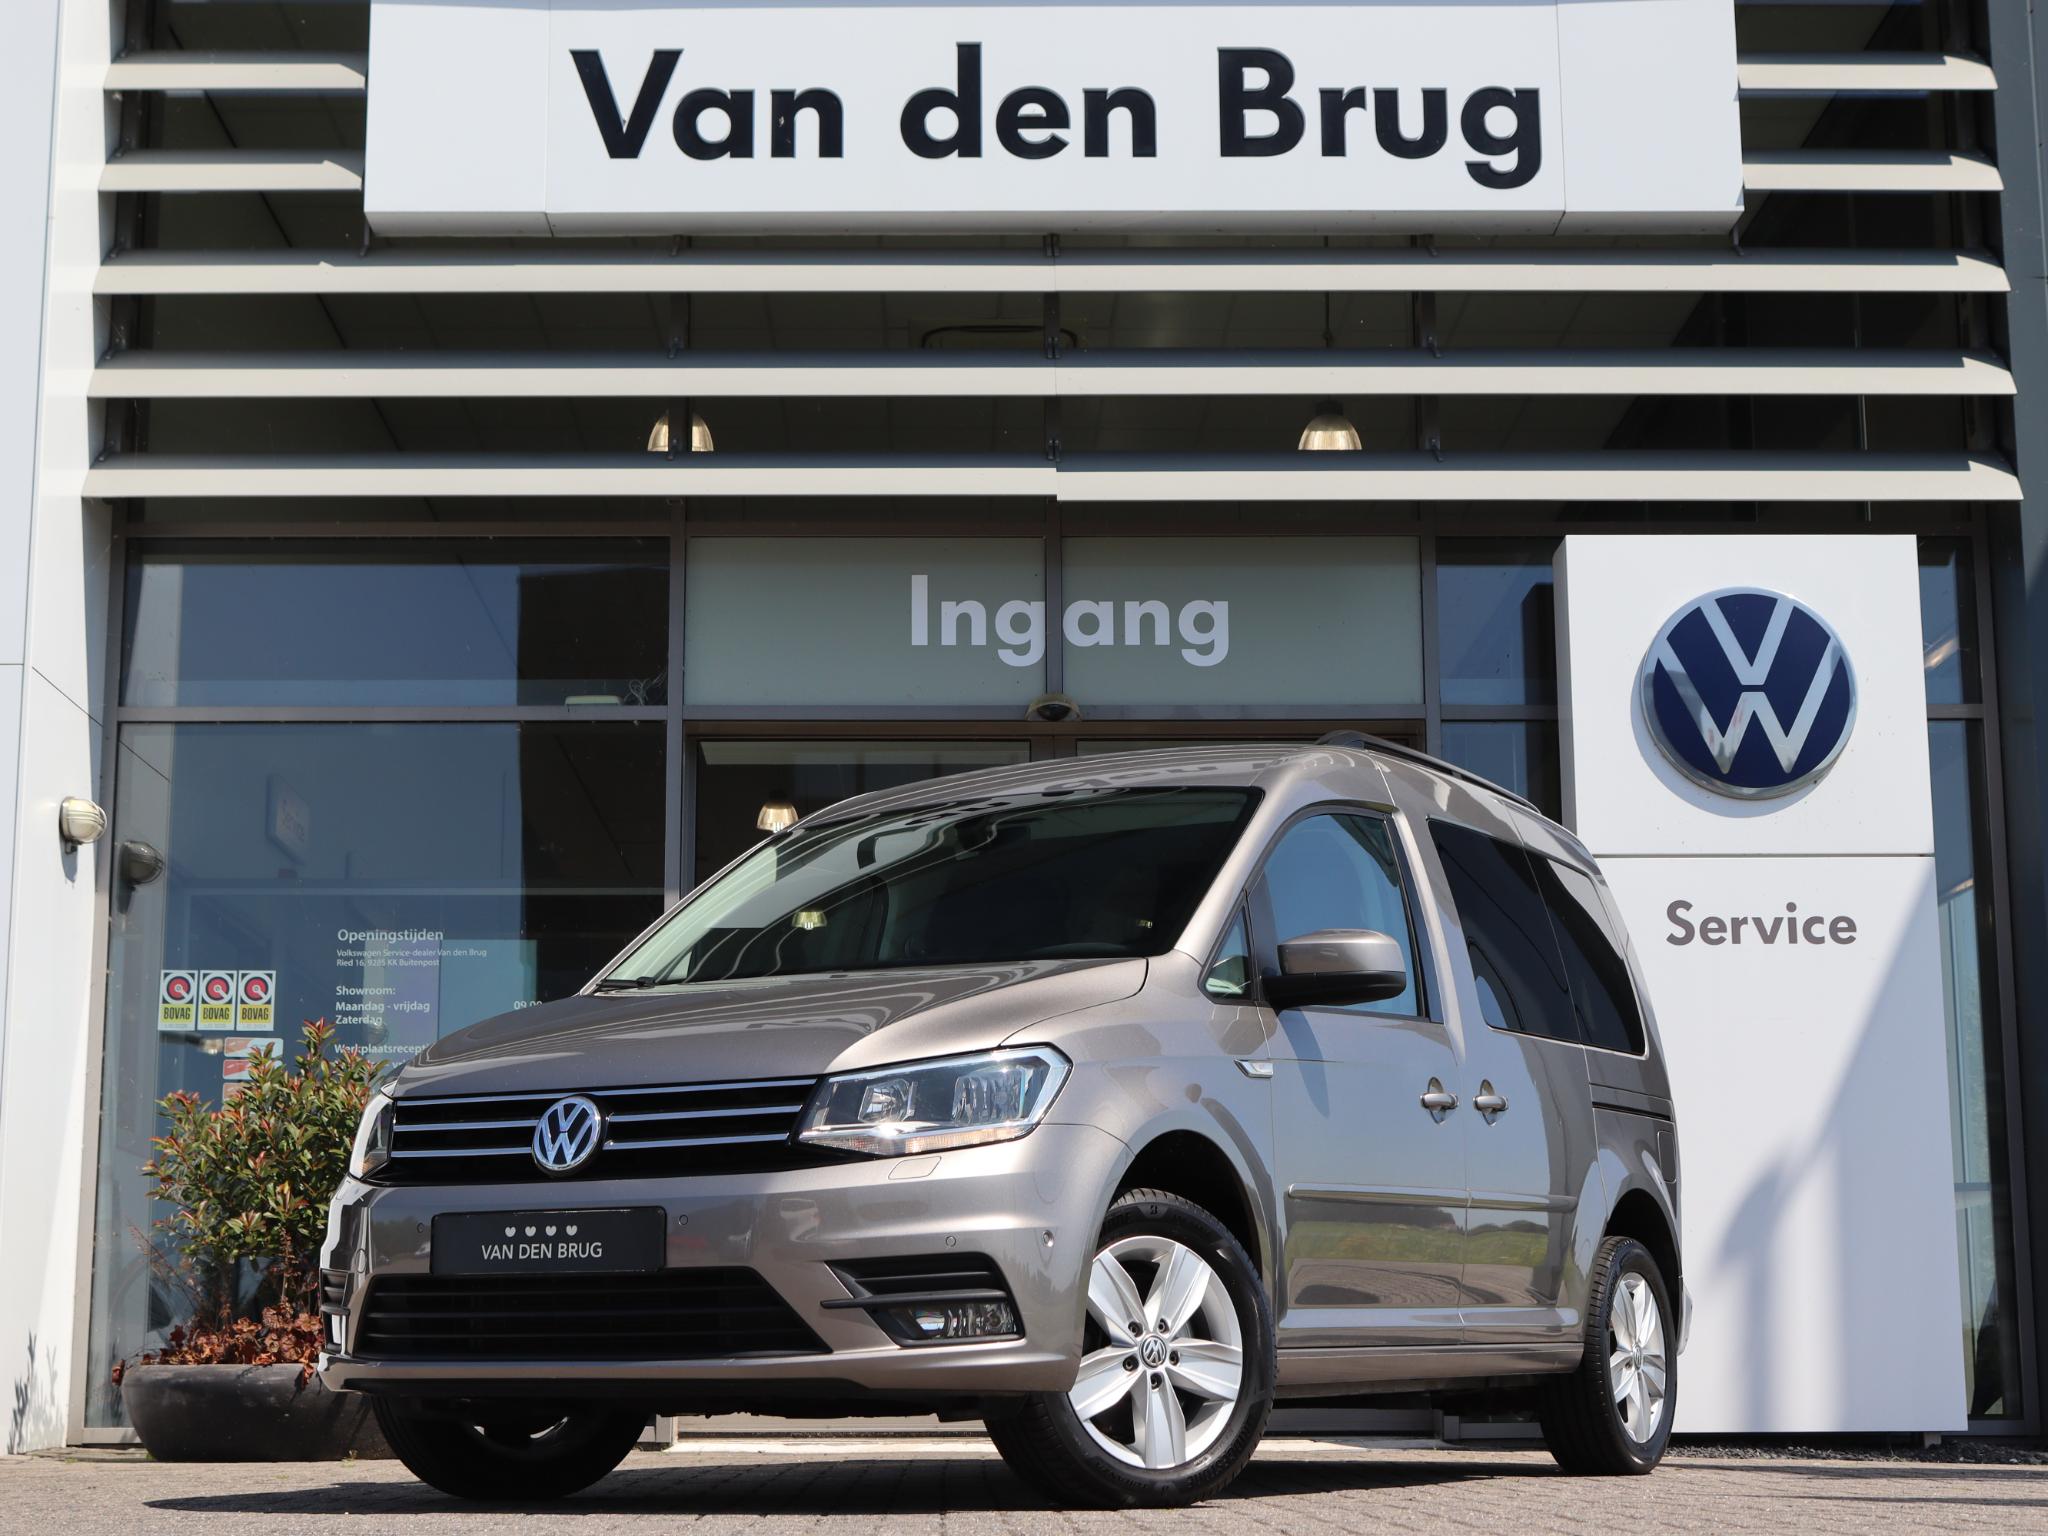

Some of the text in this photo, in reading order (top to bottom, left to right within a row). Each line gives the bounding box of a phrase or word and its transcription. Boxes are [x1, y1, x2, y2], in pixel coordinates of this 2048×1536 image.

[568, 41, 1543, 190] Van den Brug
[911, 574, 1229, 667] Ingang
[1666, 900, 1857, 946] Service
[337, 928, 444, 944] Openingstijden
[336, 948, 382, 959] Volkswagen
[336, 958, 354, 967] Ried
[336, 985, 396, 996] Showroom:
[163, 1007, 191, 1020] BOVAG
[202, 1007, 230, 1020] BOVAG
[241, 1007, 269, 1021] BOVAG
[335, 1001, 385, 1014] Maandag
[393, 1001, 430, 1013] vrijdag
[335, 1014, 383, 1026] Zaterdag
[481, 1242, 602, 1260] VAN DEN BRUG
